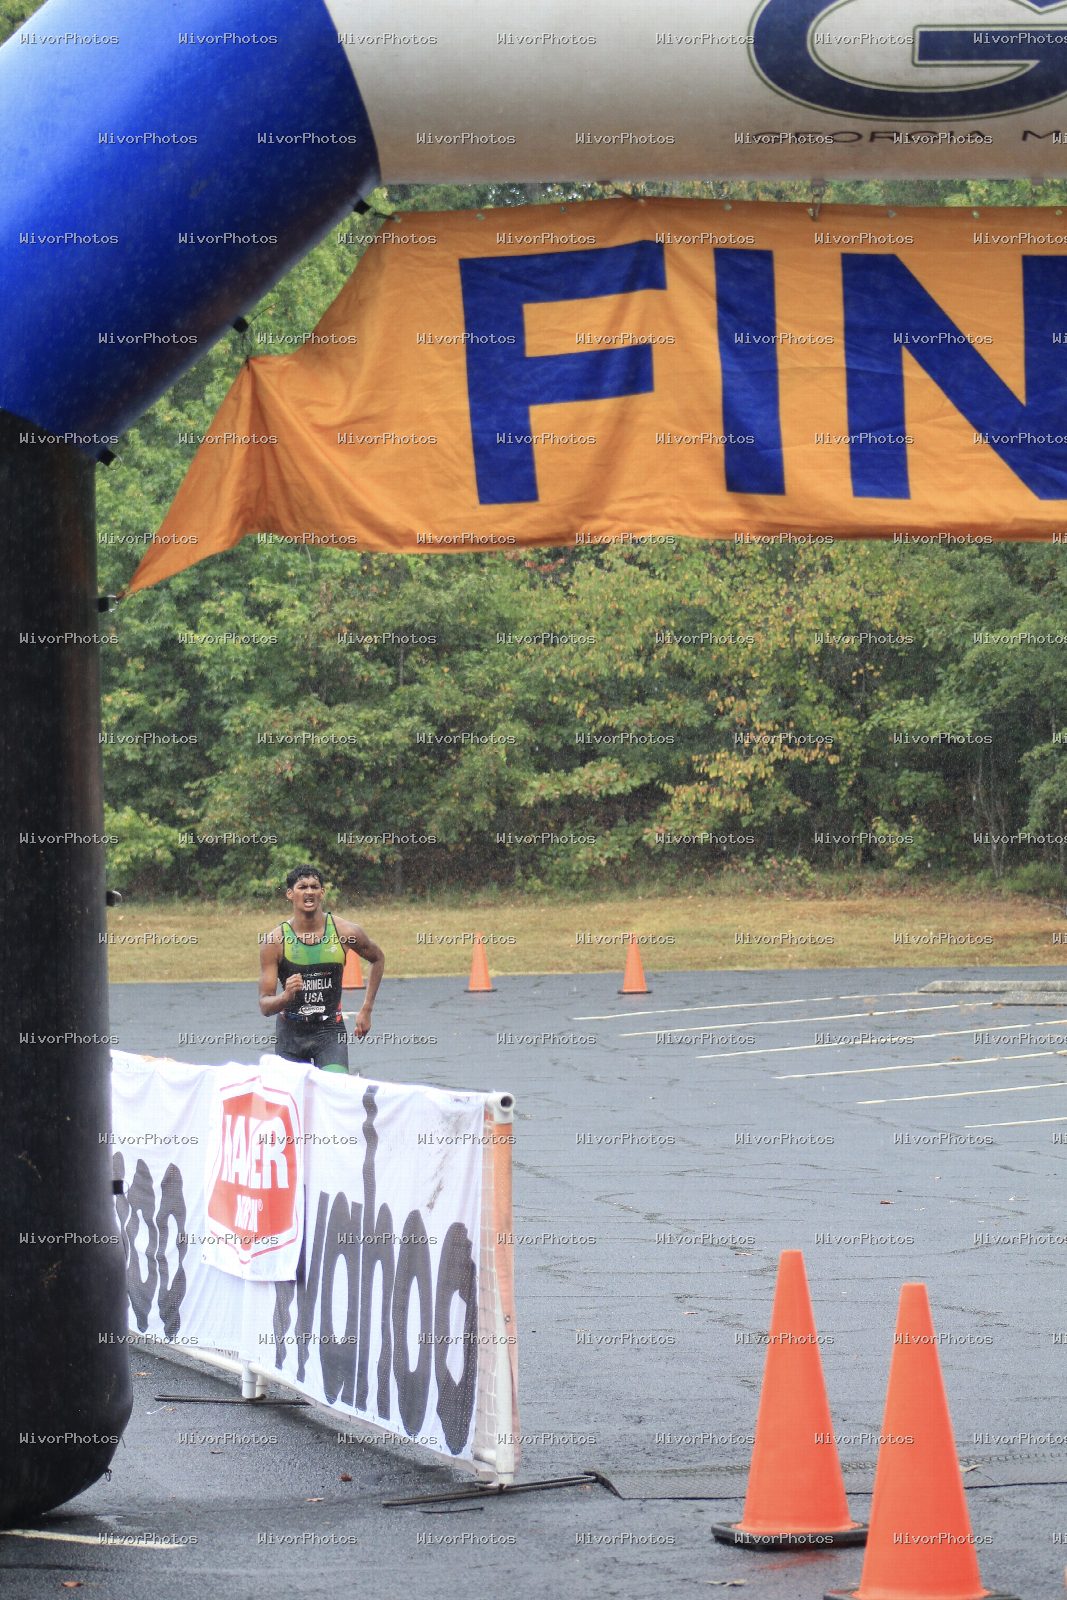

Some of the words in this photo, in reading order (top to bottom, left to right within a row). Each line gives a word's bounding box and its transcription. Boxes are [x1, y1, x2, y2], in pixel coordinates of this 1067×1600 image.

[459, 241, 1067, 504] FIN
[301, 977, 333, 991] ARIMELLA
[304, 991, 324, 1004] USA
